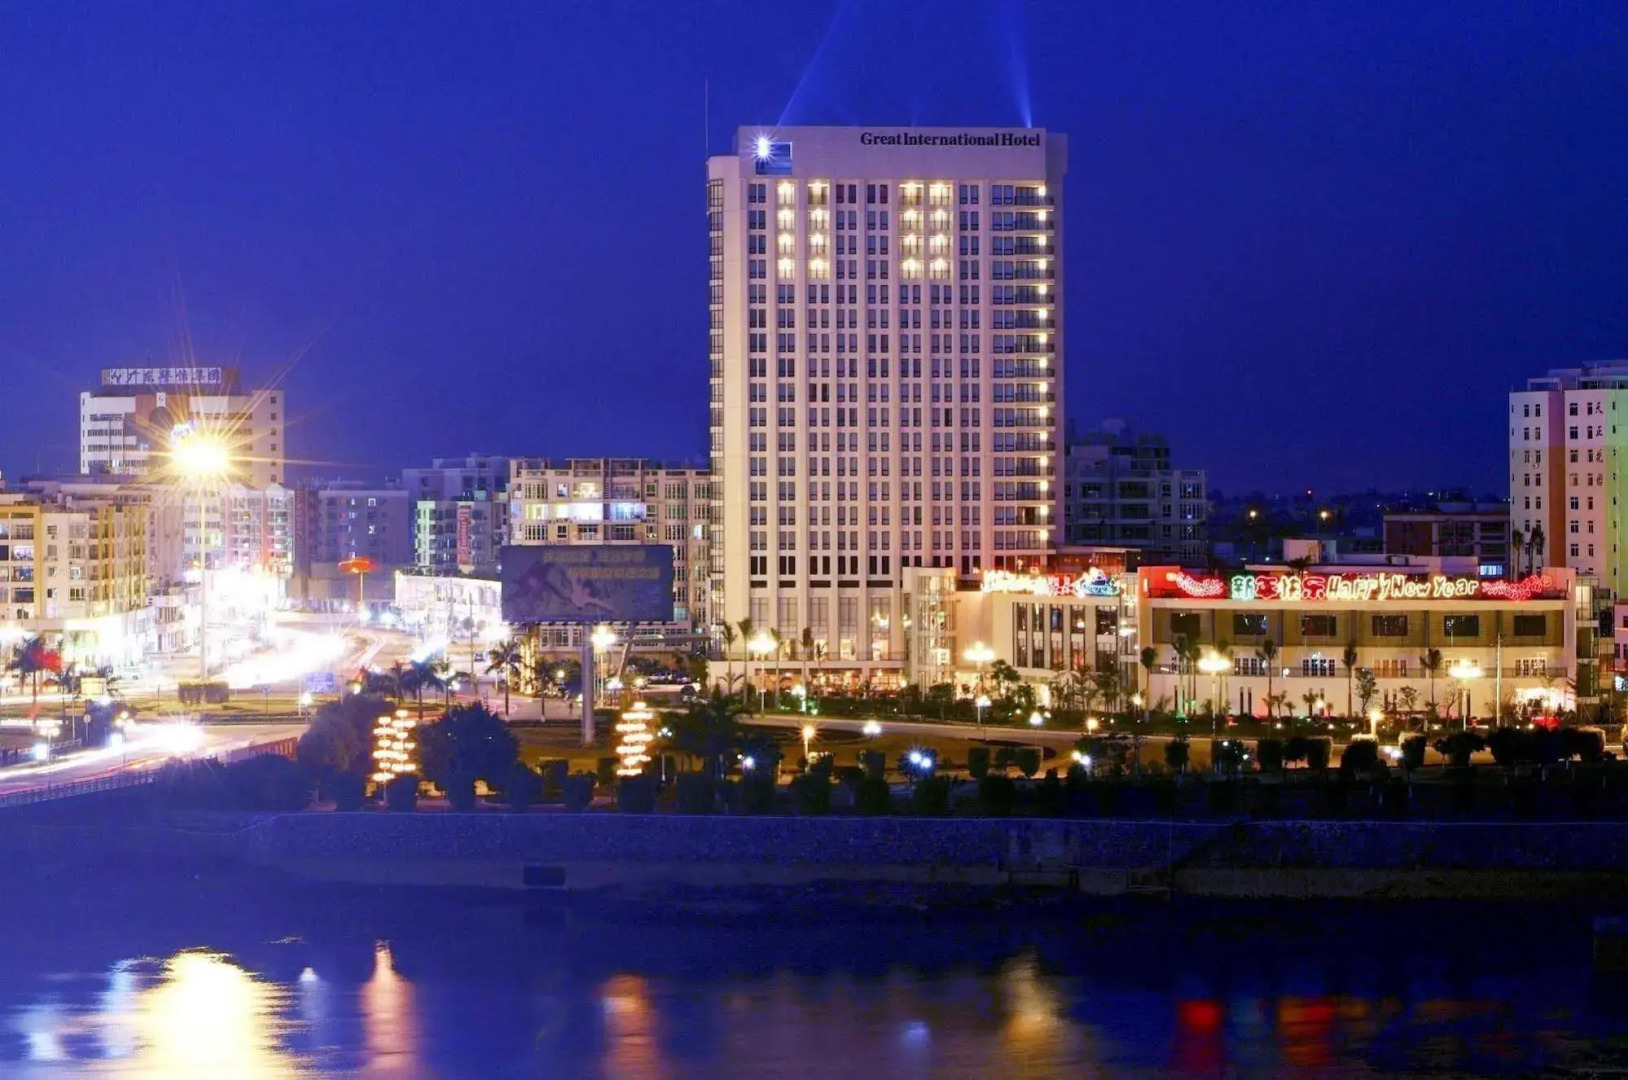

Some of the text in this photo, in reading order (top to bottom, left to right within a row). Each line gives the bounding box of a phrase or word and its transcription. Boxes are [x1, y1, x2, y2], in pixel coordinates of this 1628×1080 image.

[860, 132, 1041, 147] Great International Hotel
[1232, 575, 1326, 600] 新年快乐
[1391, 575, 1431, 598] New
[1433, 576, 1479, 597] Year
